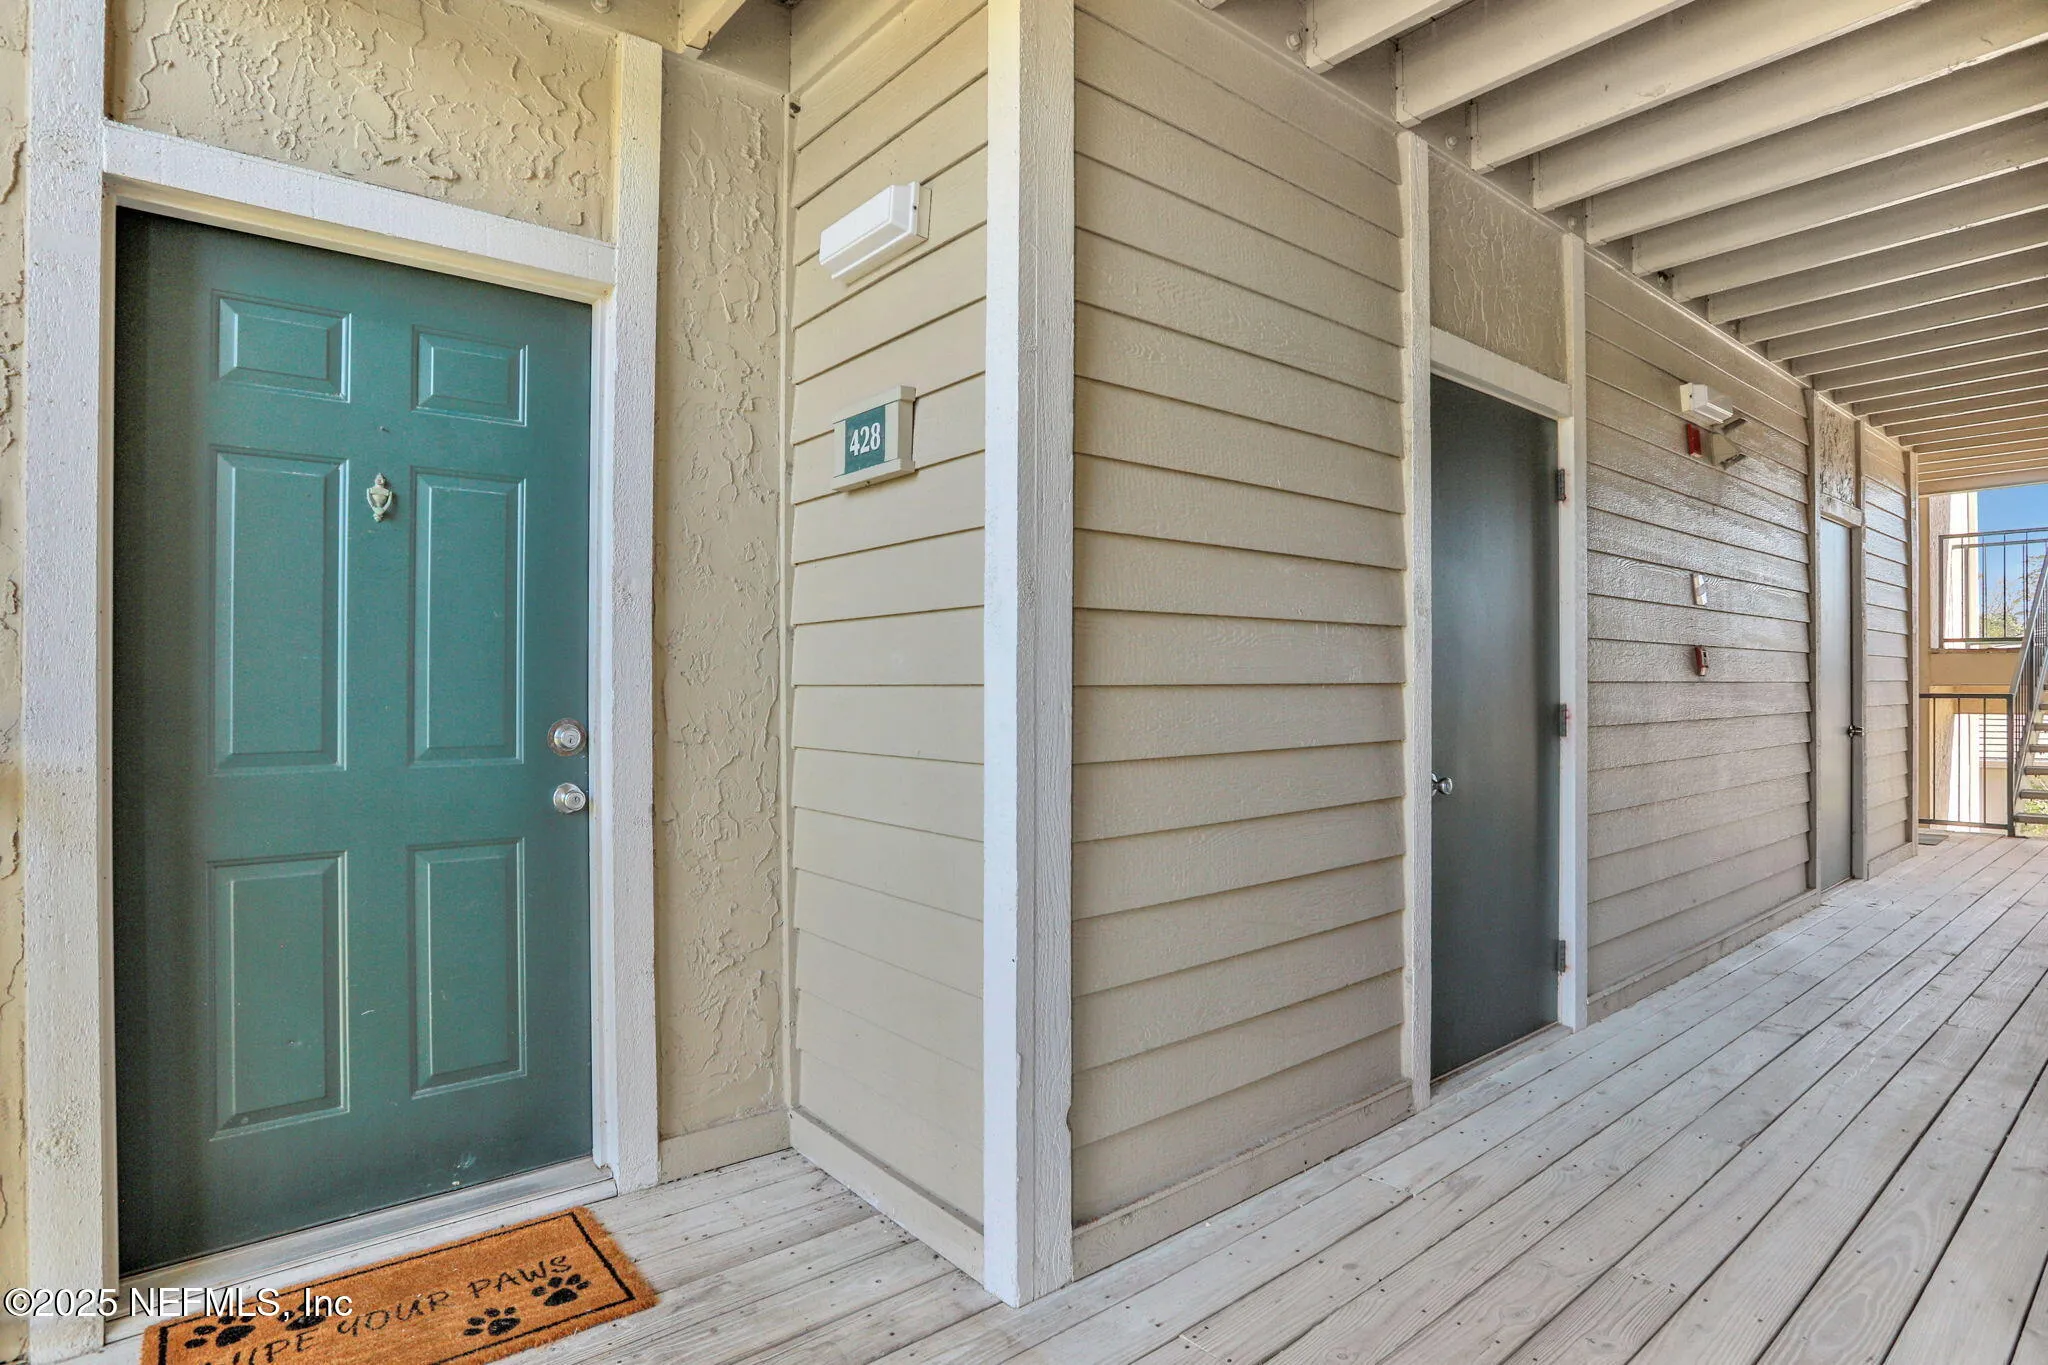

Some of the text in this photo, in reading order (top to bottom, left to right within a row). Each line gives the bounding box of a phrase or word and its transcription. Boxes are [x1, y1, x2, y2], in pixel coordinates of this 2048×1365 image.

[849, 422, 881, 456] 428
[337, 1290, 451, 1336] YOUR
[467, 1255, 572, 1298] PAWS
